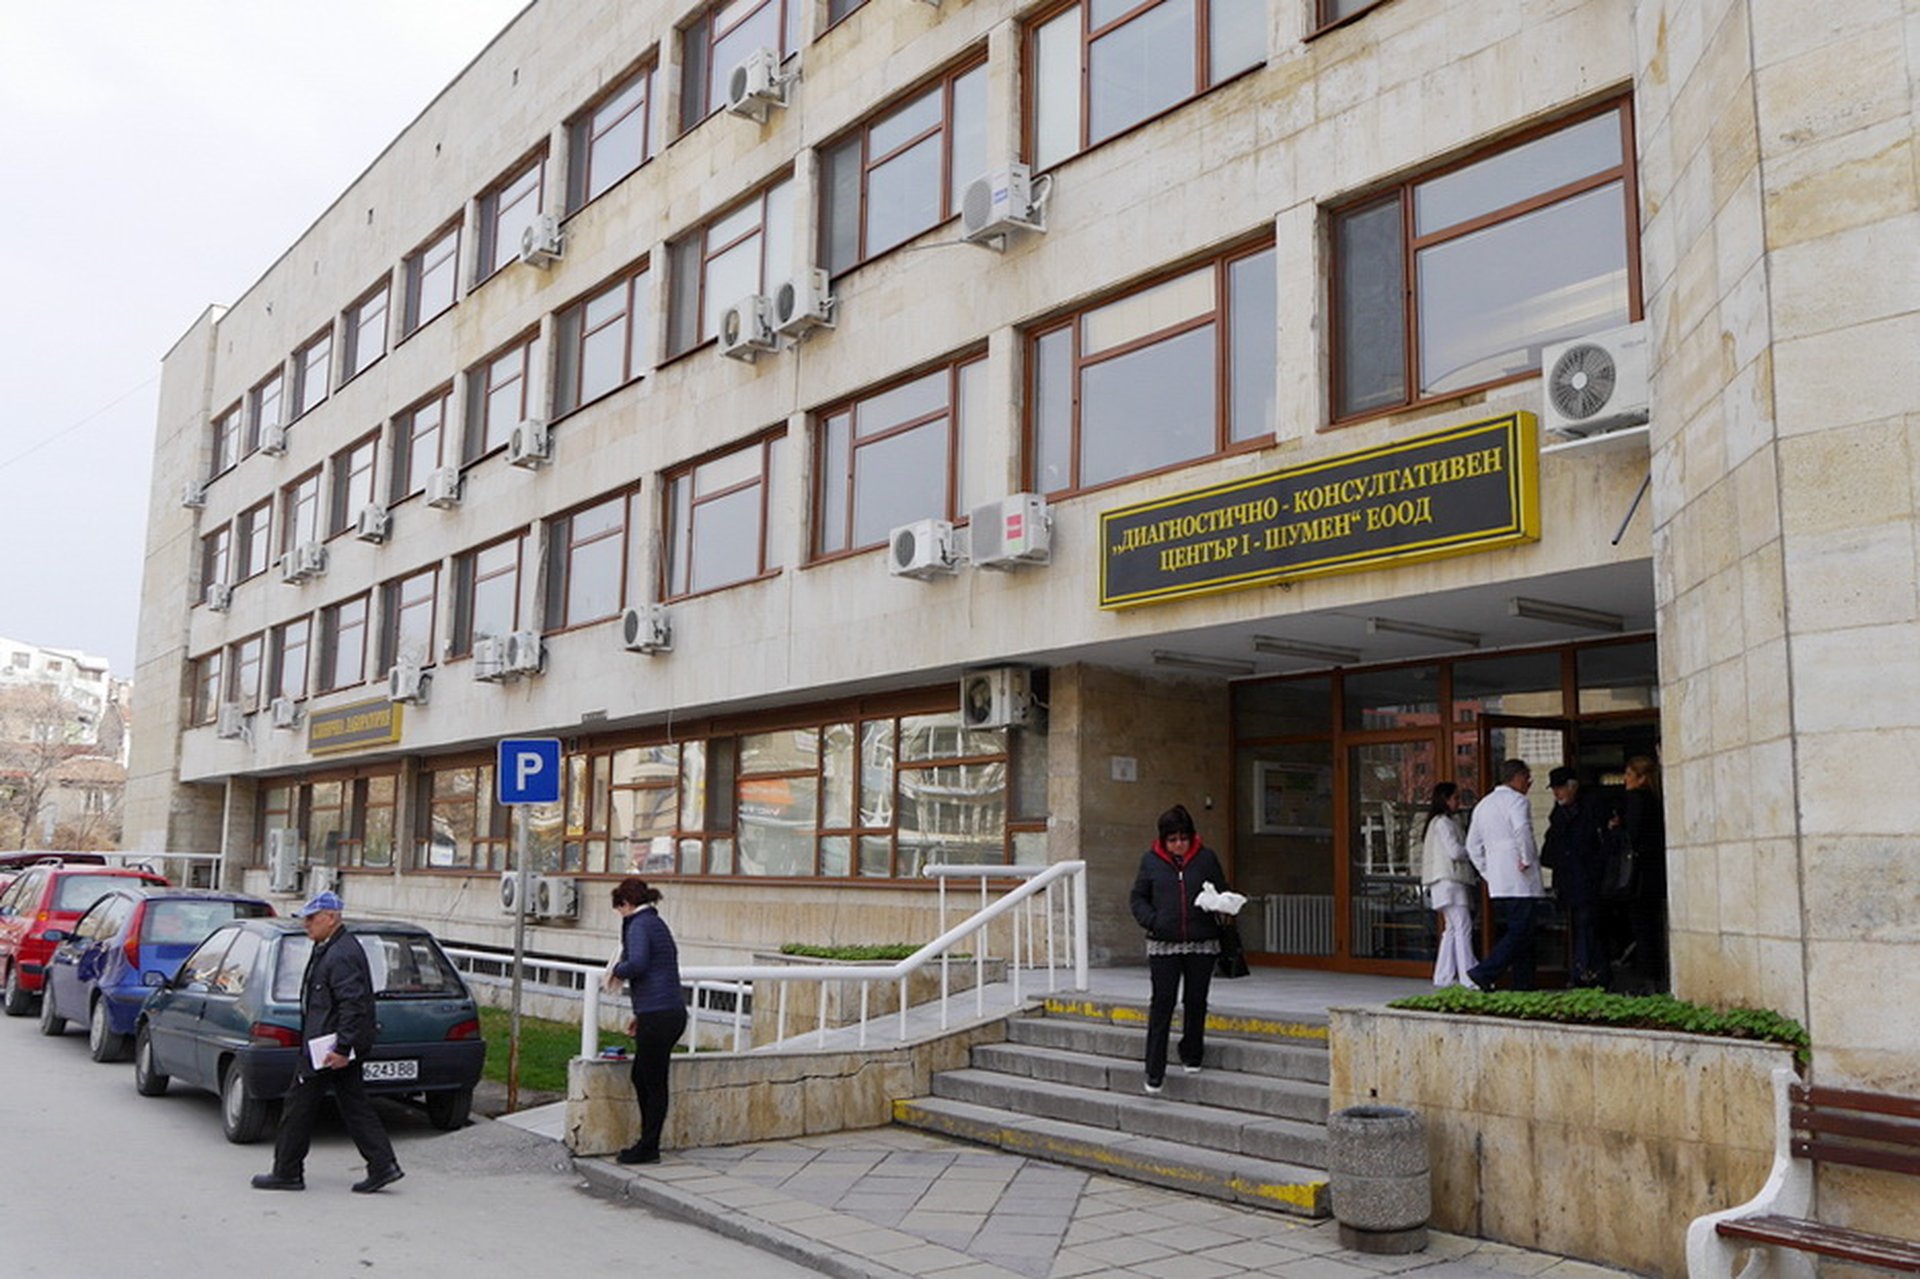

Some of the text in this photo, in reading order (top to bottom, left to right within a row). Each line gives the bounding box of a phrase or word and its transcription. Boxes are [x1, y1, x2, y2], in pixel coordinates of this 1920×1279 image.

[1293, 448, 1503, 513] КОНСУЛТАТИВЕН
[1159, 536, 1238, 572] ЦЕНТЪР
[1366, 496, 1433, 532] ЕООД
[516, 752, 544, 791] P
